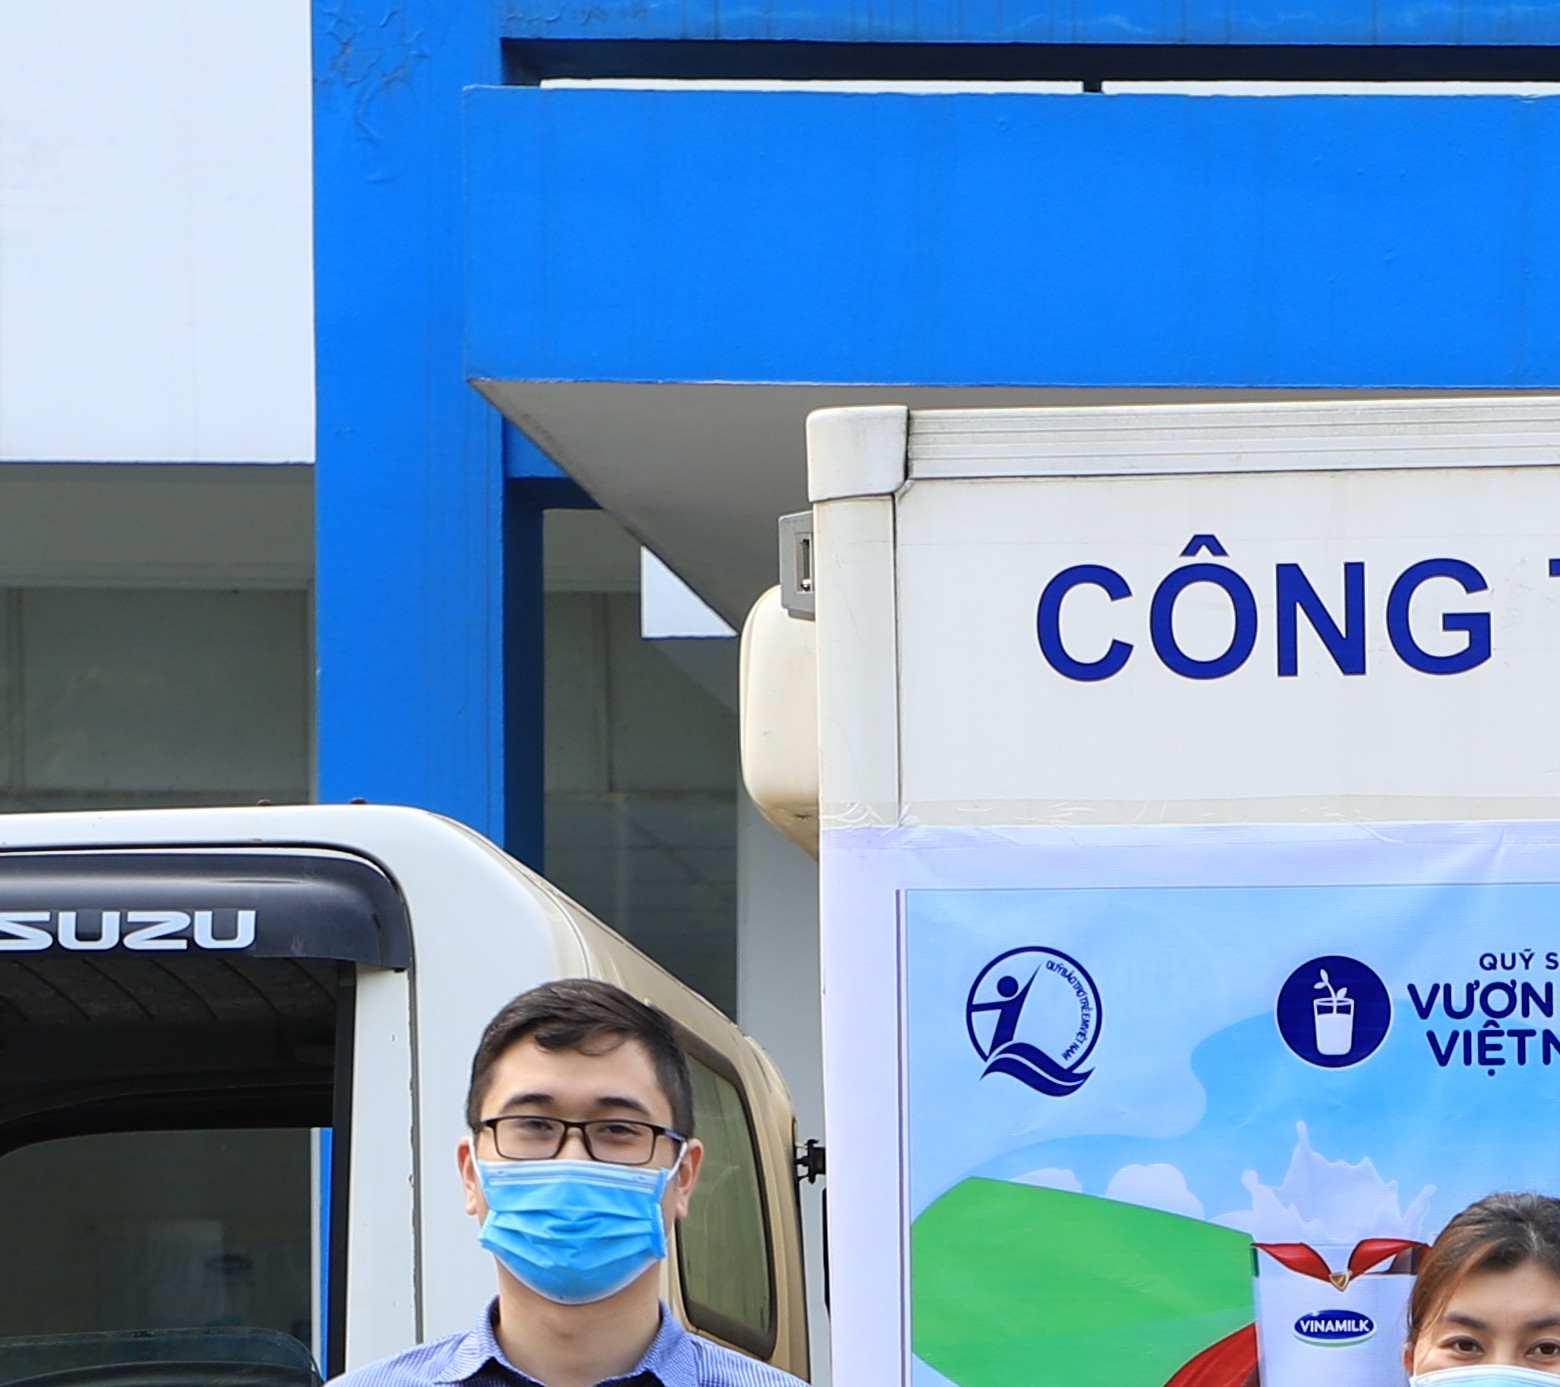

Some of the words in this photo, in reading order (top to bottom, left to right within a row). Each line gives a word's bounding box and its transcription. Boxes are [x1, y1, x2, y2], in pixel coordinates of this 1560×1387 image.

[1038, 535, 1491, 680] CÔNG
[1479, 946, 1533, 971] QUỸ
[1407, 979, 1551, 1019] VƯƠN
[1426, 1022, 1525, 1076] VIỆT
[1298, 1316, 1370, 1334] VINAMILK
